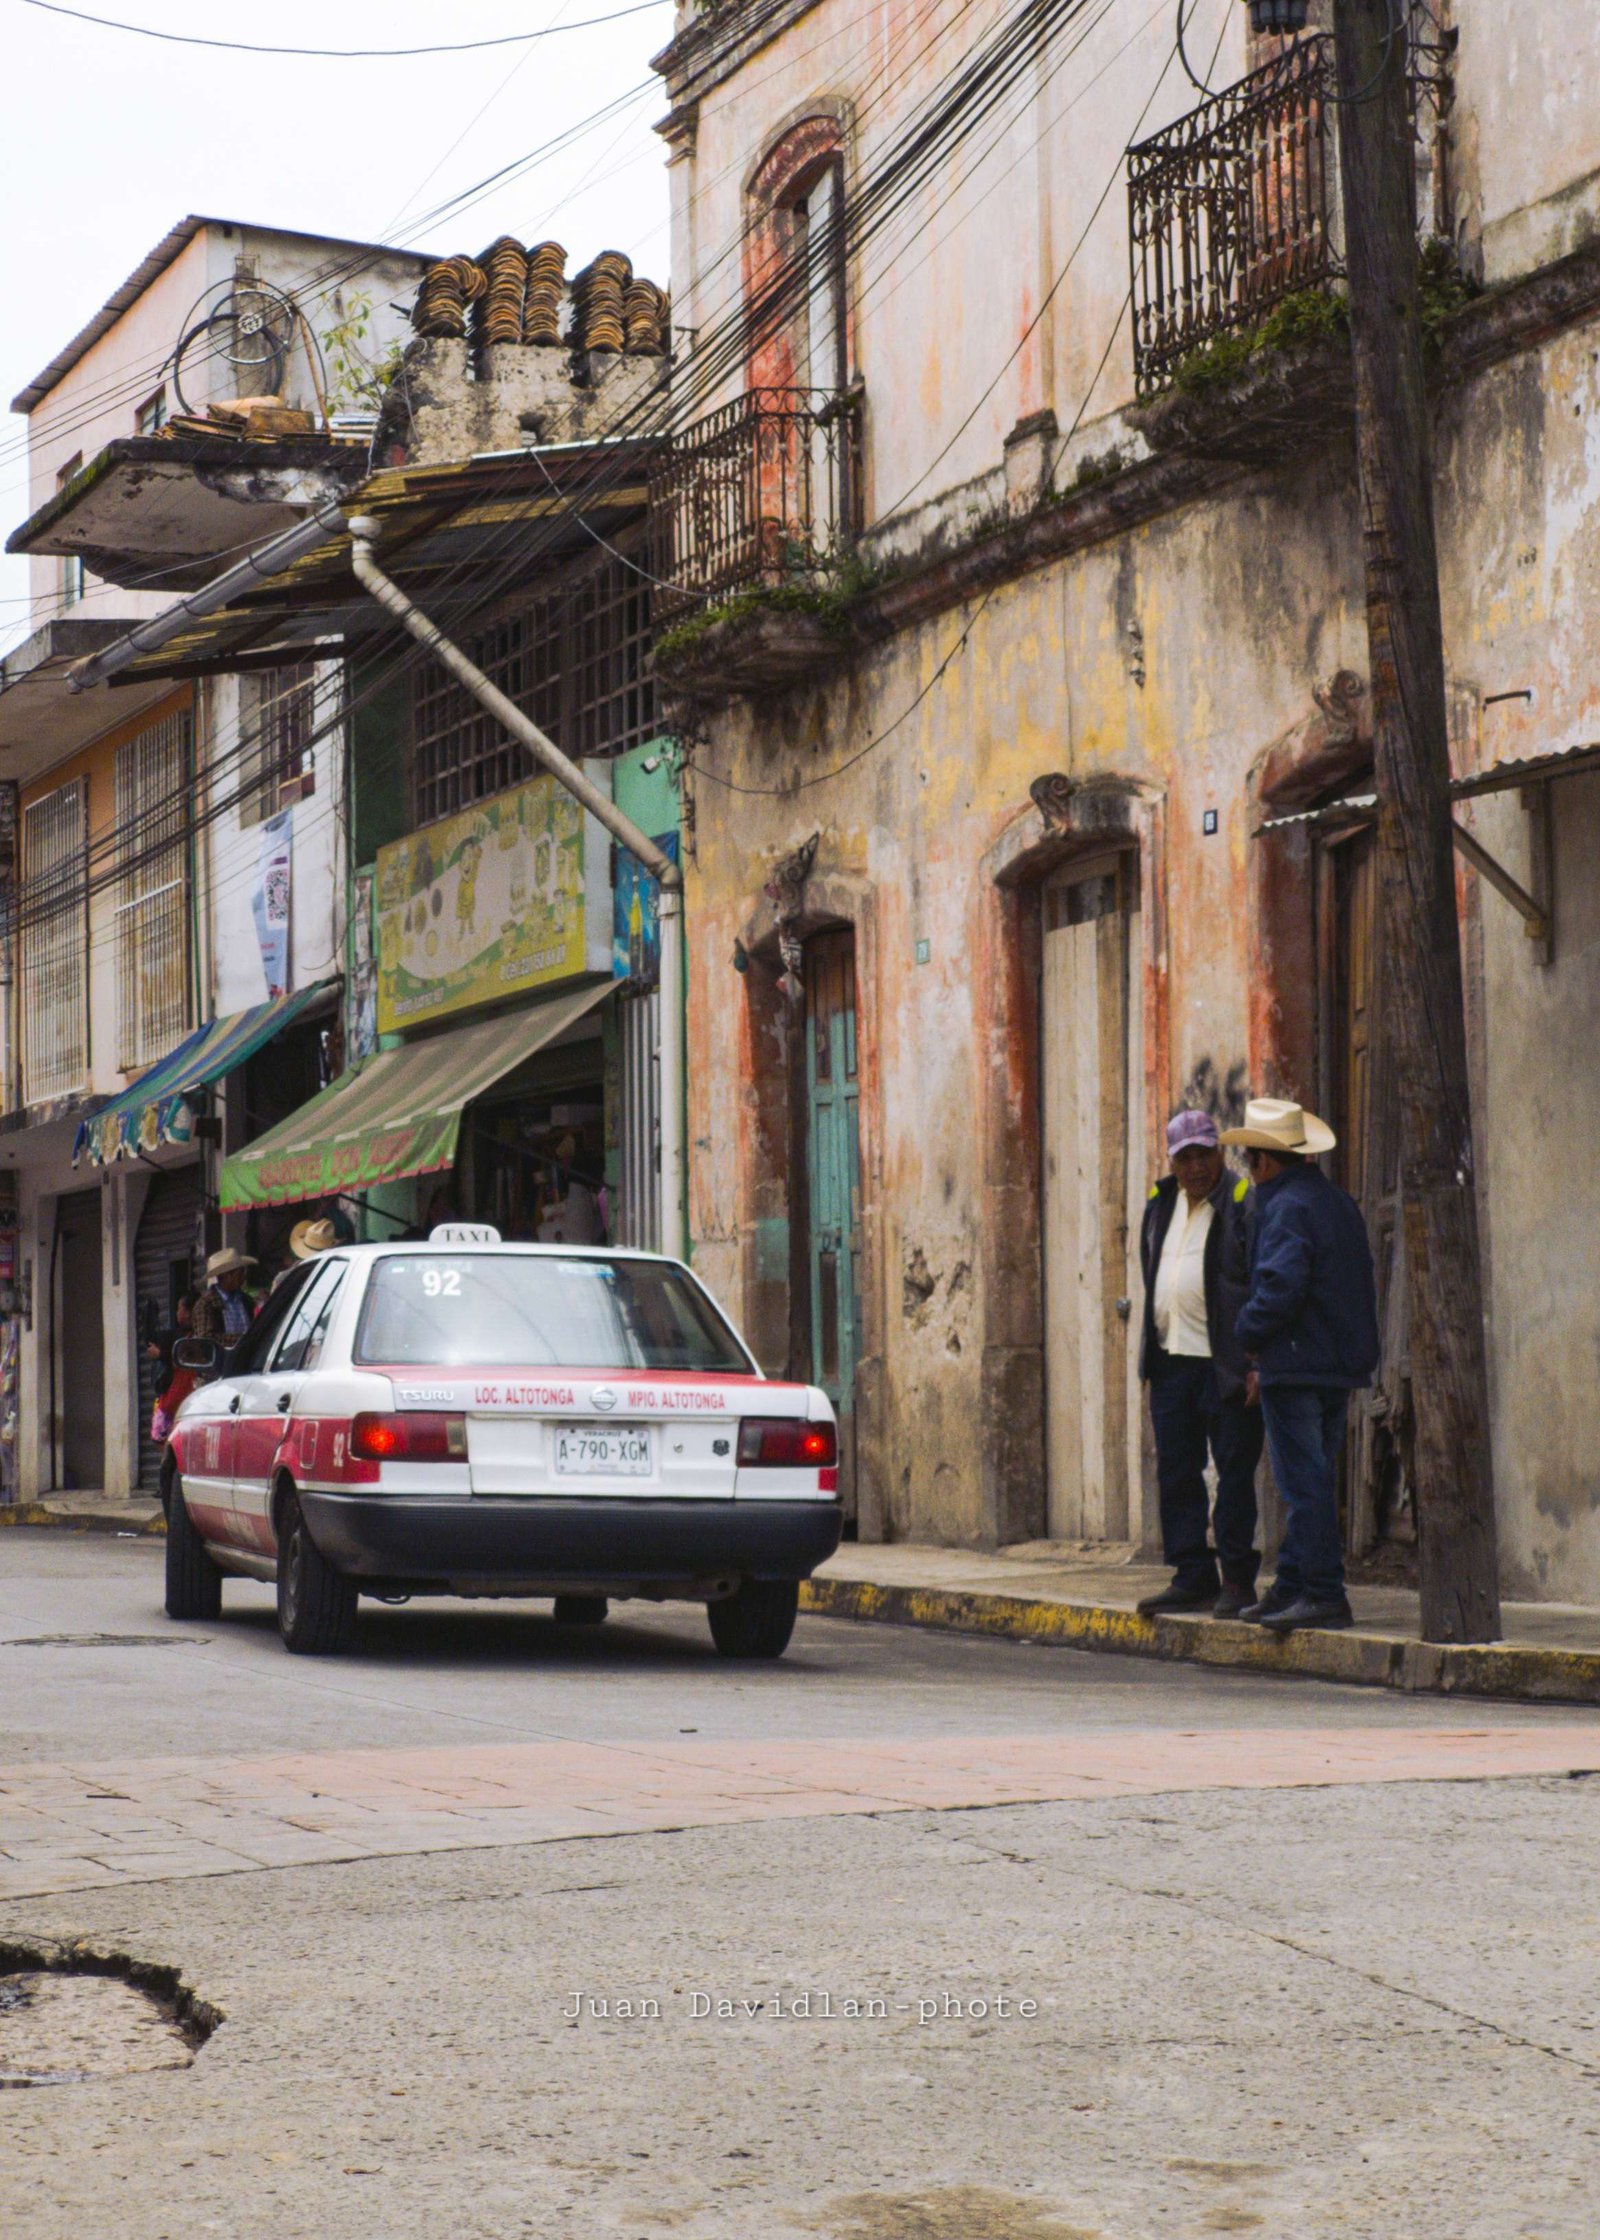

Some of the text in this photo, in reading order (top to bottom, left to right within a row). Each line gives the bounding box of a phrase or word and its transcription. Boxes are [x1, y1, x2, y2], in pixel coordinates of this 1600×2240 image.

[441, 1229, 490, 1242] TAXI
[422, 1269, 462, 1296] 92
[400, 1390, 454, 1401] TSURU
[475, 1387, 574, 1405] LOC. ALTOTONGA
[628, 1391, 725, 1409] MPIO. ALTOTONGA
[559, 1439, 649, 1461] A-790-XGM
